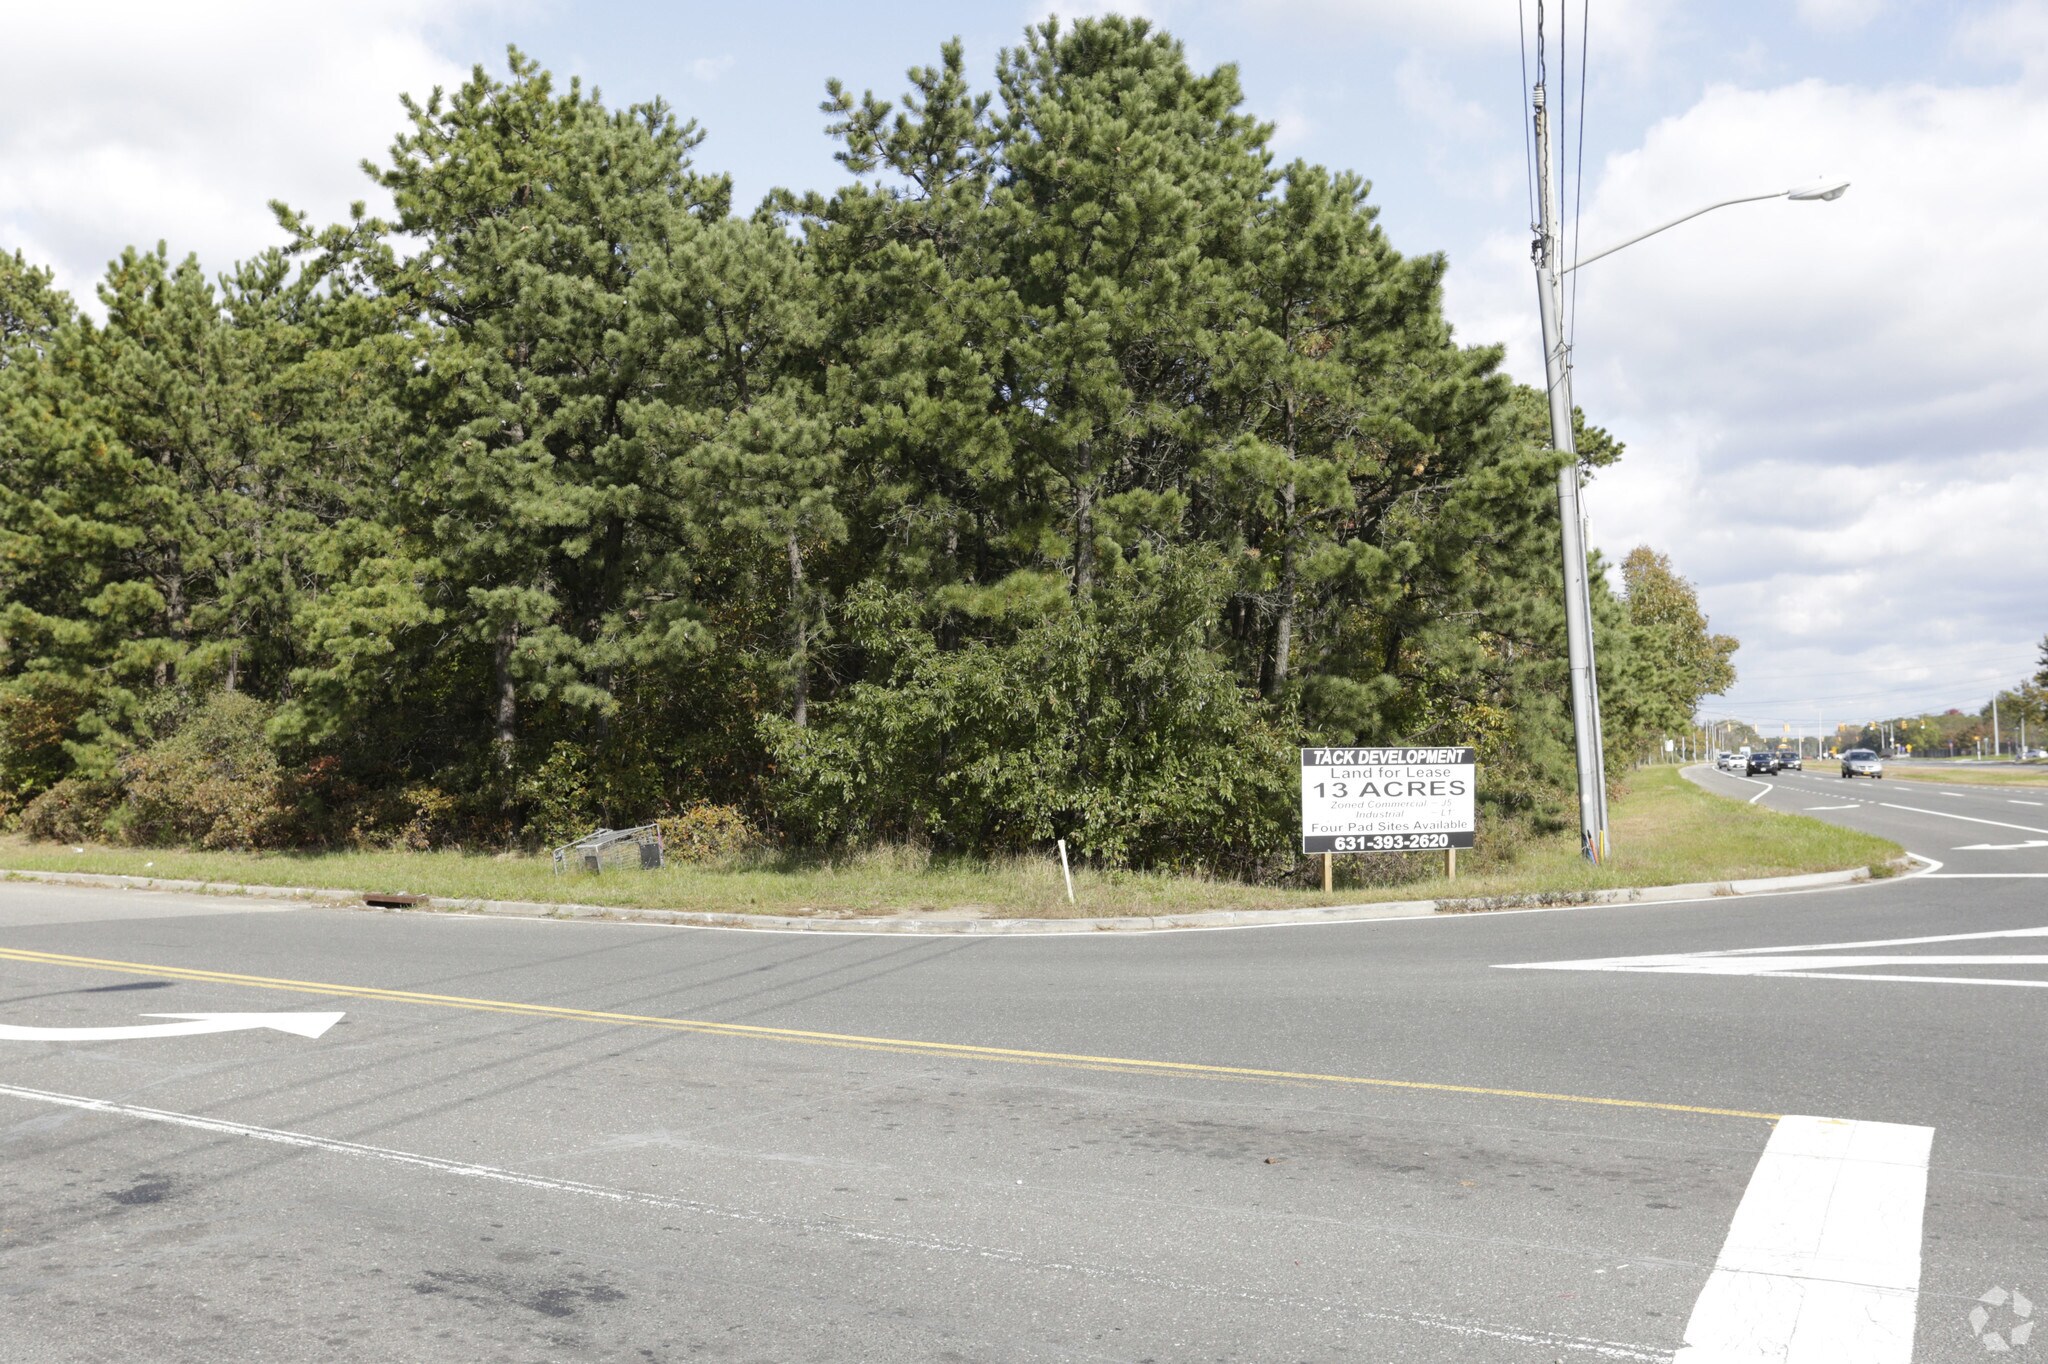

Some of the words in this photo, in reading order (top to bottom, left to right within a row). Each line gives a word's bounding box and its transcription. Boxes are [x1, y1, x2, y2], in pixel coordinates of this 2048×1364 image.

[1314, 750, 1354, 765] TACK
[1358, 750, 1465, 764] DEVELOPMENT
[1331, 768, 1372, 778] Land
[1379, 767, 1400, 778] for
[1407, 768, 1451, 777] Lease
[1314, 782, 1348, 798] 13
[1359, 781, 1465, 797] ACRES
[1331, 801, 1364, 809] Zoned
[1368, 800, 1427, 808] Commercial
[1356, 810, 1404, 818] Industrial
[1312, 823, 1342, 832] Four
[1348, 823, 1372, 831] Pad
[1378, 822, 1409, 831] Sites
[1414, 821, 1467, 829] Available
[1335, 834, 1448, 850] 631-393-2620
